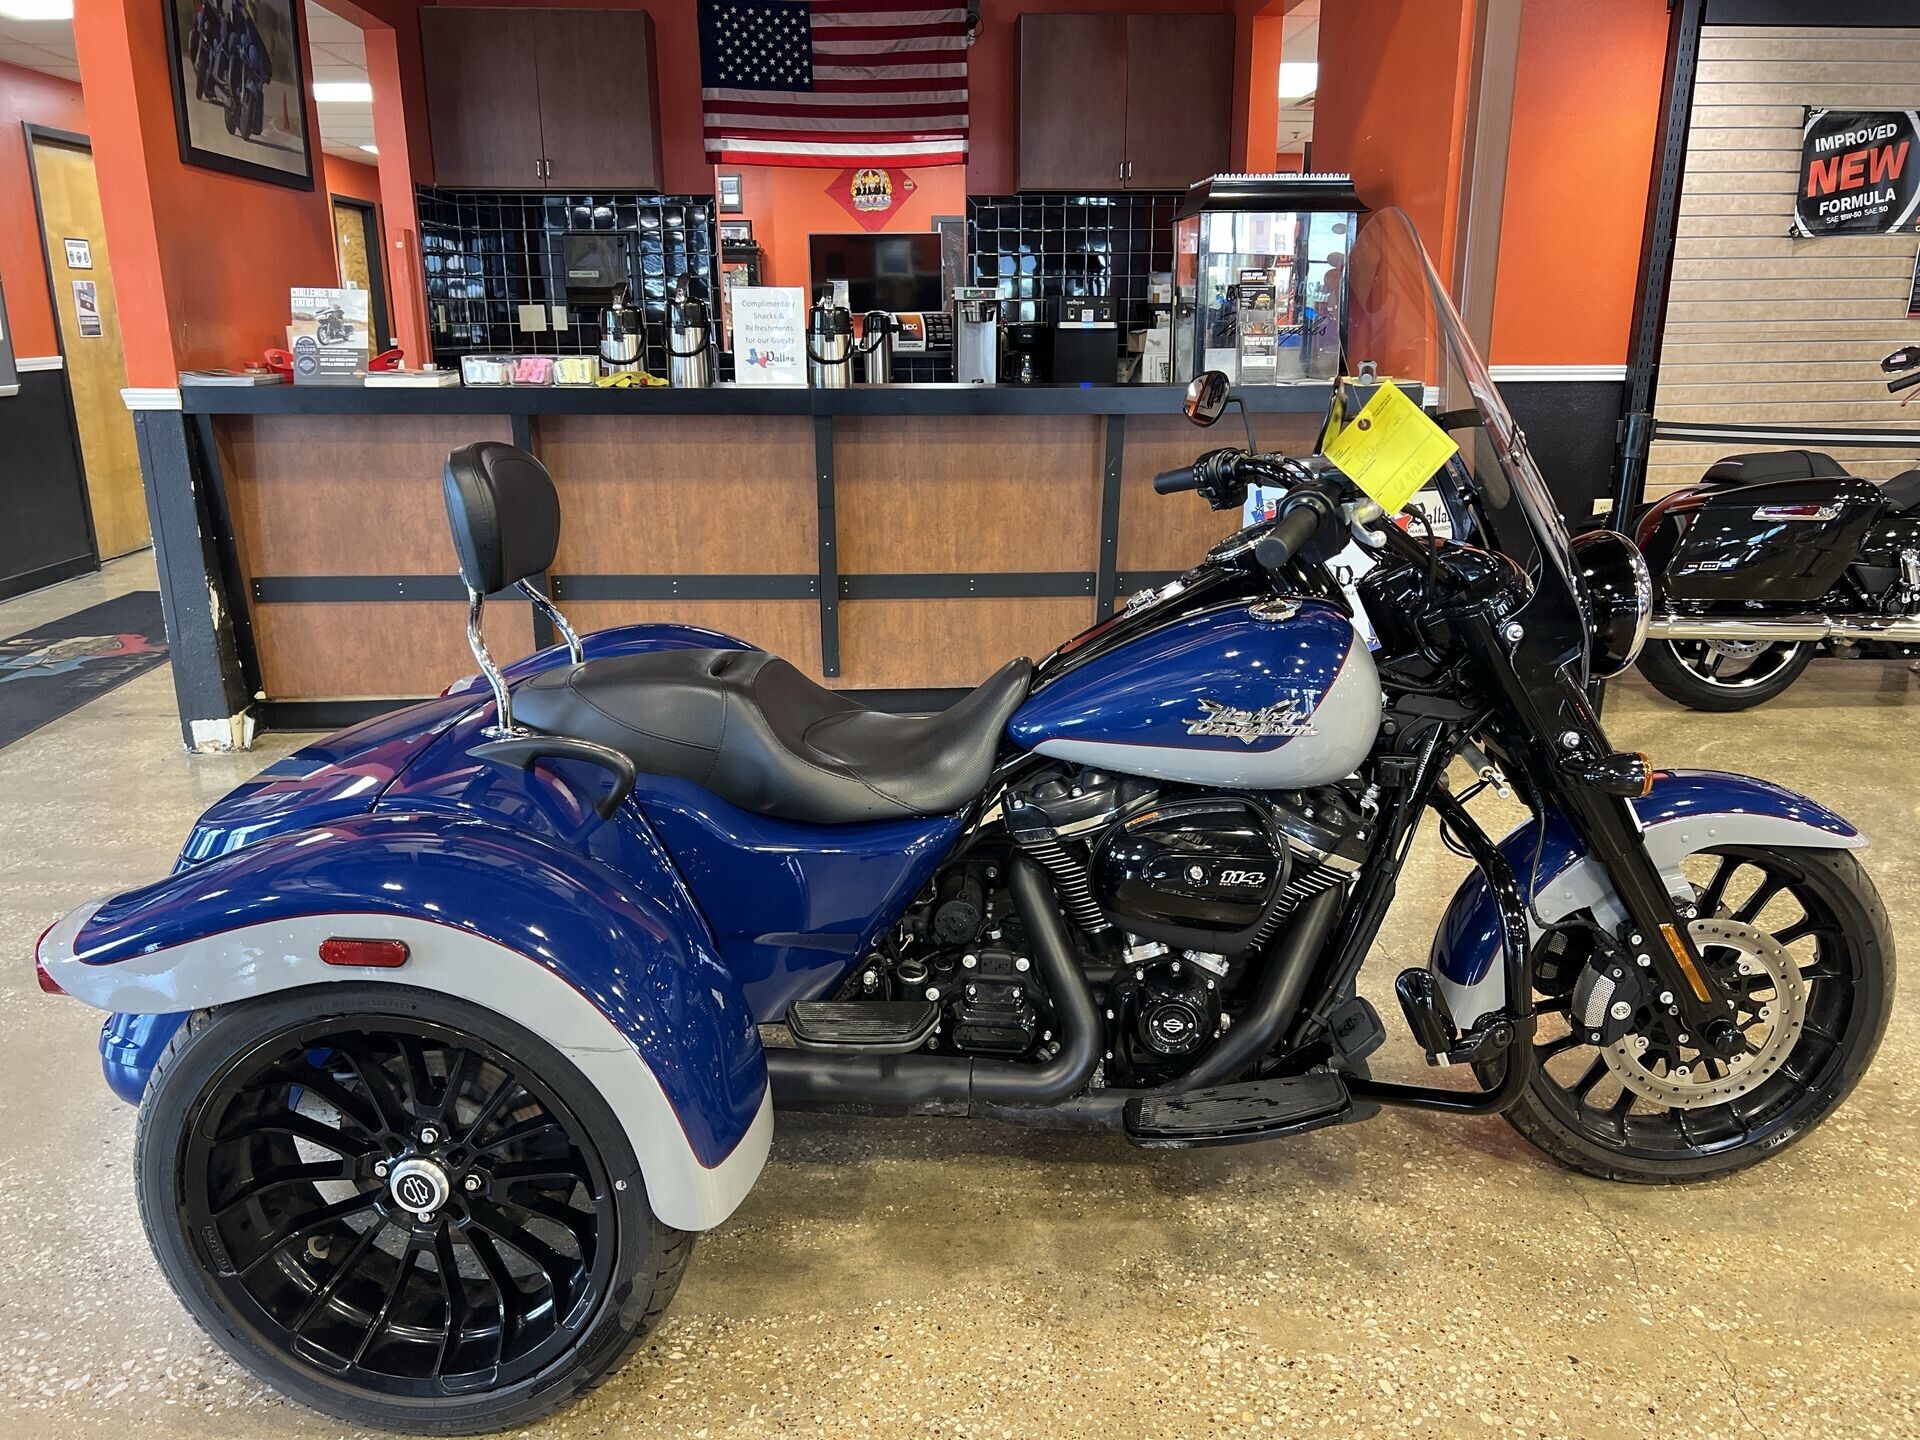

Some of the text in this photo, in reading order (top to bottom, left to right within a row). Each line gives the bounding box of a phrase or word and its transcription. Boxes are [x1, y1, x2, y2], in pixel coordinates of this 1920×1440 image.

[1815, 123, 1898, 153] IMPROVED
[1807, 141, 1910, 198] NEW
[854, 196, 892, 209] TEXAS
[1819, 188, 1897, 216] FORMULA
[1826, 215, 1840, 224] SAE
[1864, 207, 1878, 216] SAE
[1879, 205, 1889, 213] 50
[291, 288, 328, 298] CHALLENGE
[291, 297, 314, 307] STATUS
[742, 300, 796, 309] Complimentay
[753, 312, 777, 320] Snacks
[745, 324, 794, 332] Refreshments
[1408, 501, 1451, 526] Dalla
[1220, 870, 1266, 885] 114
